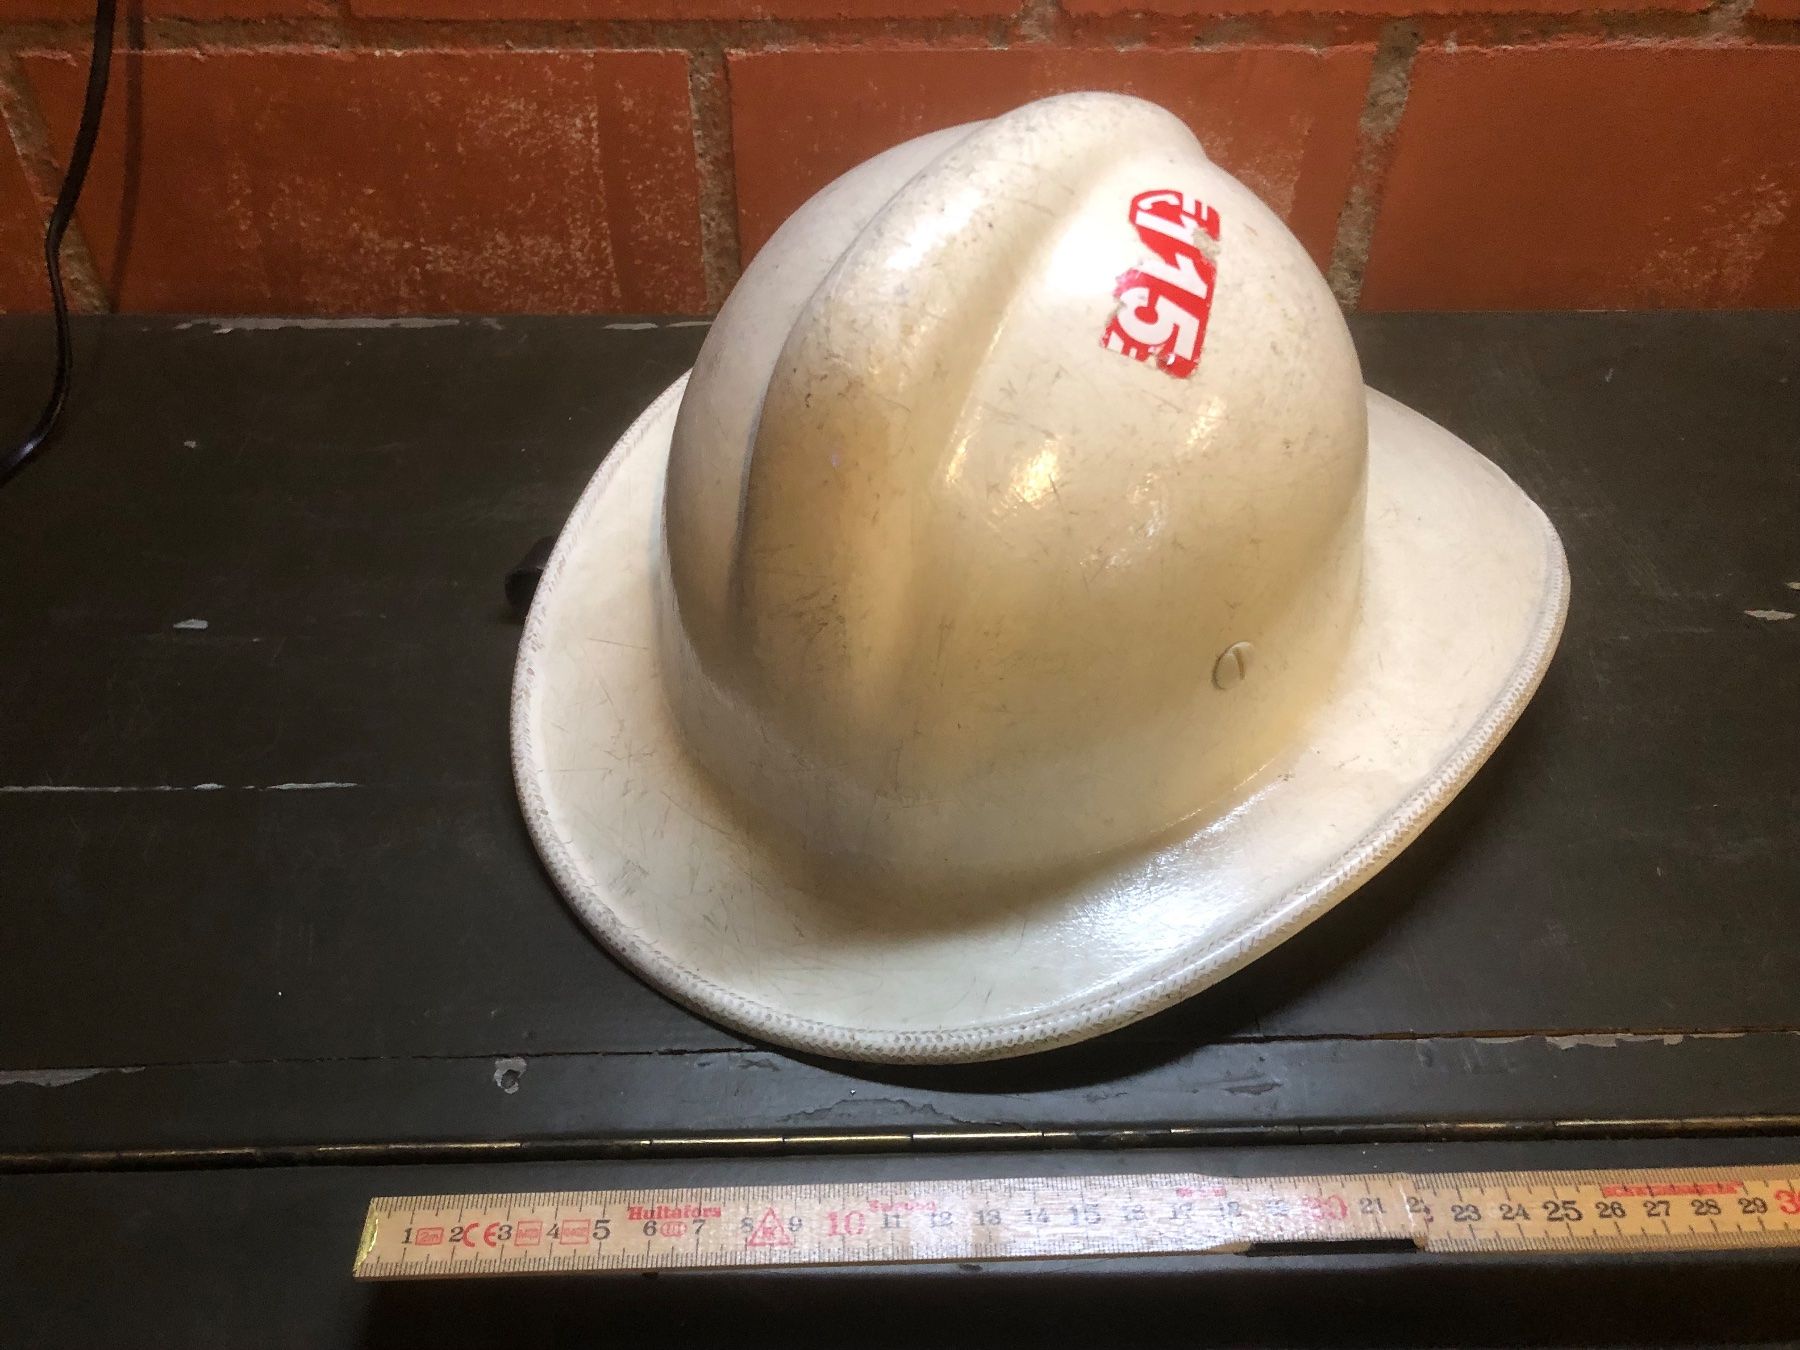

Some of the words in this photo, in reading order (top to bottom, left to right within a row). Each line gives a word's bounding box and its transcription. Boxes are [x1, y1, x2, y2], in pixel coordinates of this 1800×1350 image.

[1117, 211, 1208, 360] 115
[402, 1227, 413, 1245] 1
[450, 1227, 464, 1243] 2
[498, 1225, 512, 1241] 3
[546, 1223, 560, 1239] 4
[593, 1219, 611, 1241] 5
[643, 1220, 657, 1237] 6
[692, 1219, 706, 1235] 7
[788, 1216, 802, 1232] 9
[826, 1210, 866, 1237] 10
[883, 1213, 901, 1229] 11
[1070, 1203, 1102, 1226] 15
[1360, 1197, 1387, 1214] 21
[1451, 1204, 1481, 1222] 23
[1500, 1203, 1531, 1221] 24
[1542, 1200, 1583, 1222] 25
[1595, 1201, 1626, 1219] 26
[1643, 1200, 1671, 1217] 27
[1691, 1198, 1722, 1216] 28
[1738, 1197, 1768, 1214] 29
[1775, 1190, 1800, 1215] 3
[628, 1204, 721, 1221] Hultafors
